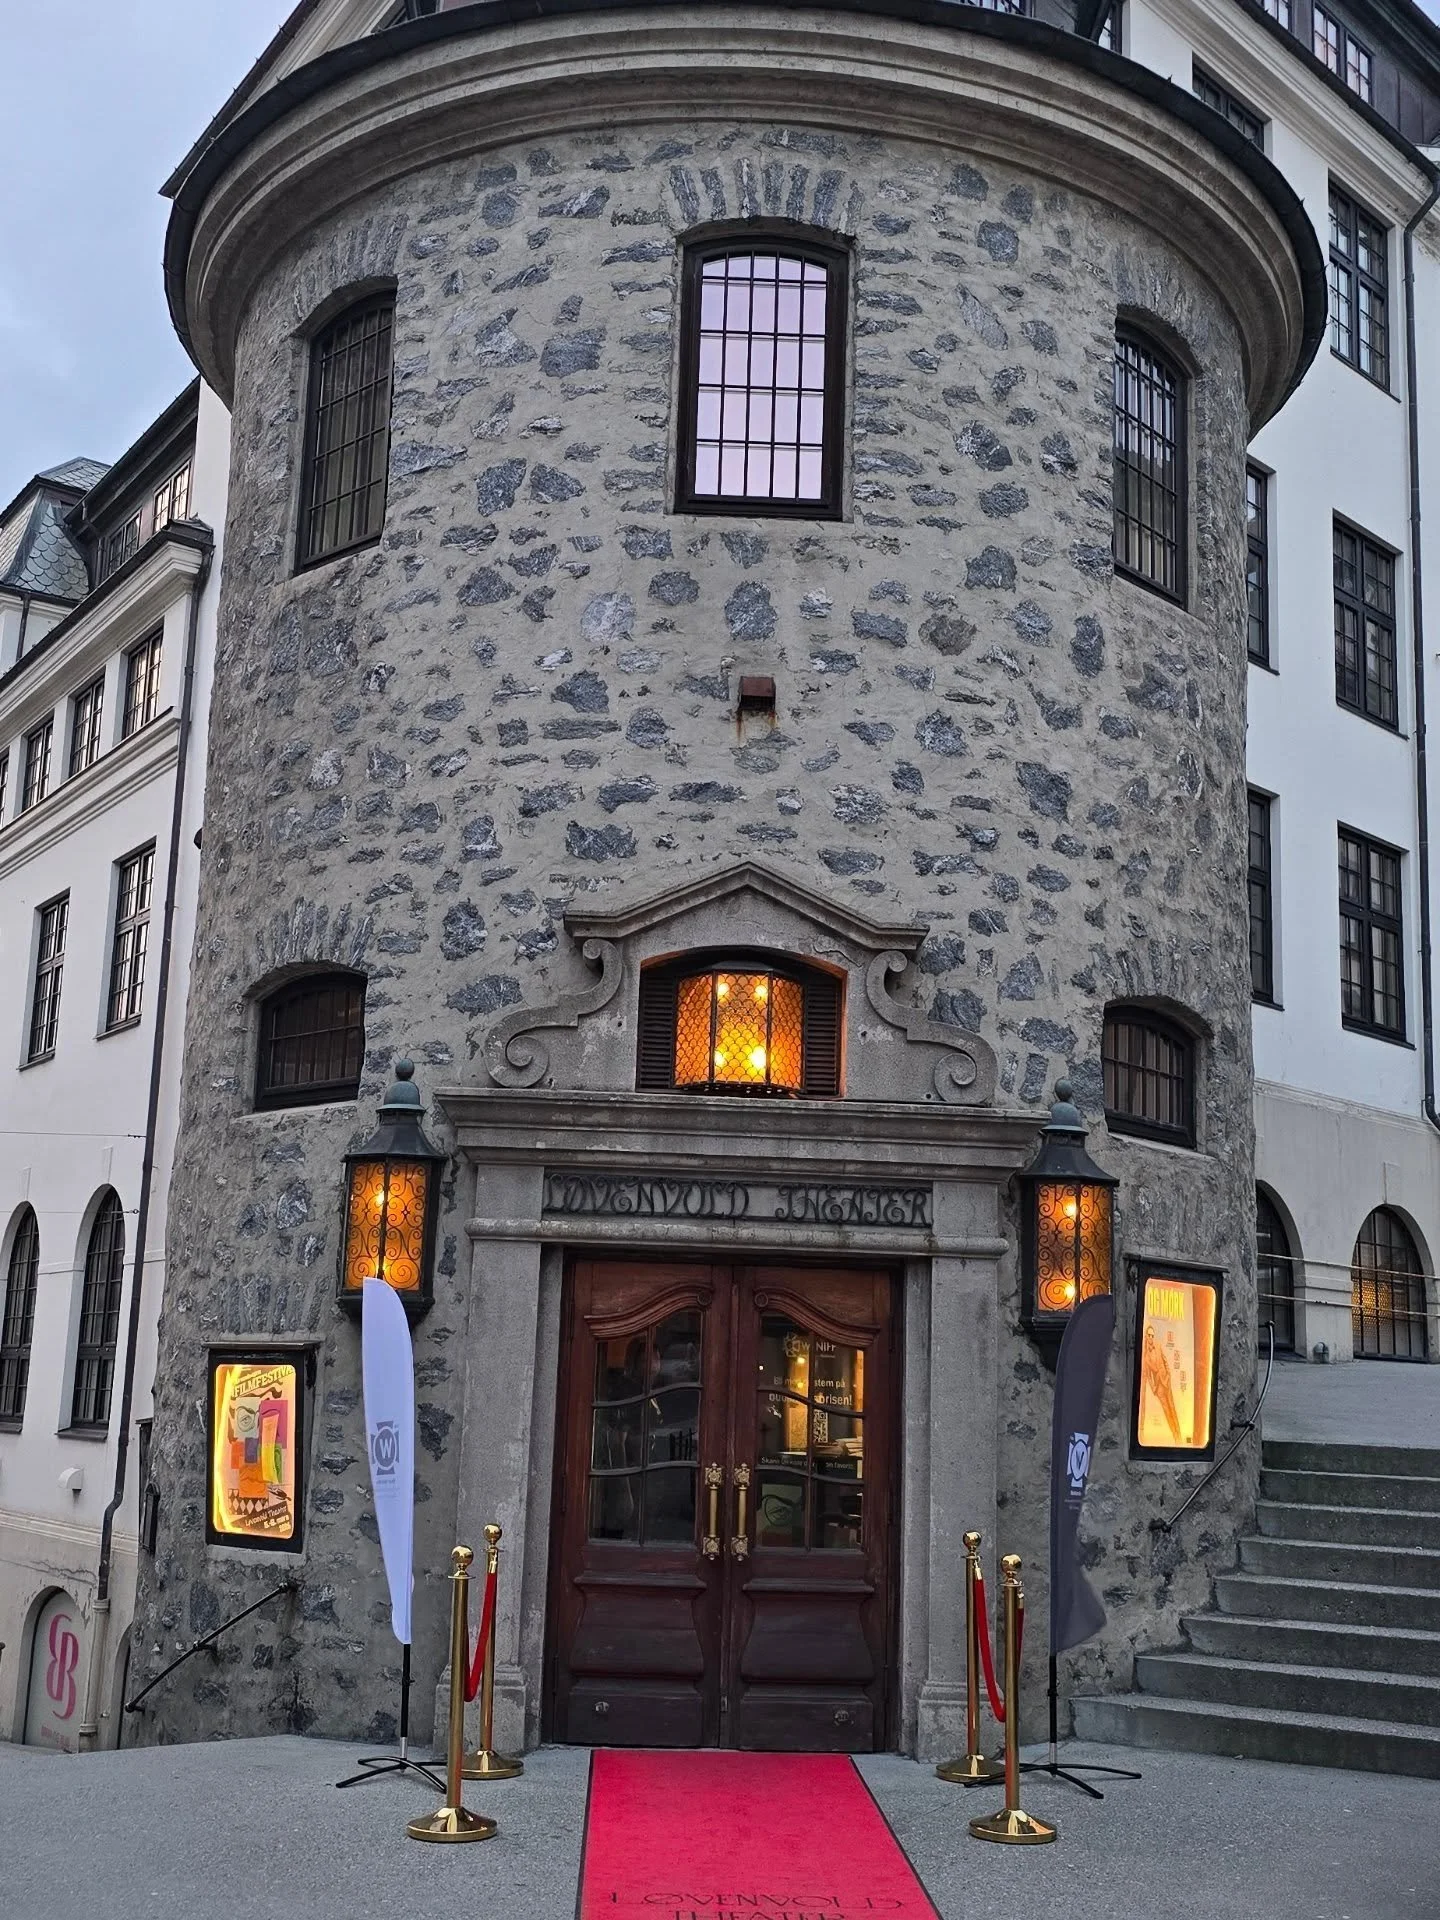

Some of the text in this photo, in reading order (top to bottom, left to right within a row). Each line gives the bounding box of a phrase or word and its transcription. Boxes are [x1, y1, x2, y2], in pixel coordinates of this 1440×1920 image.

[544, 1173, 931, 1226] LØVENVOLD THEATER
[380, 1437, 393, 1459] W
